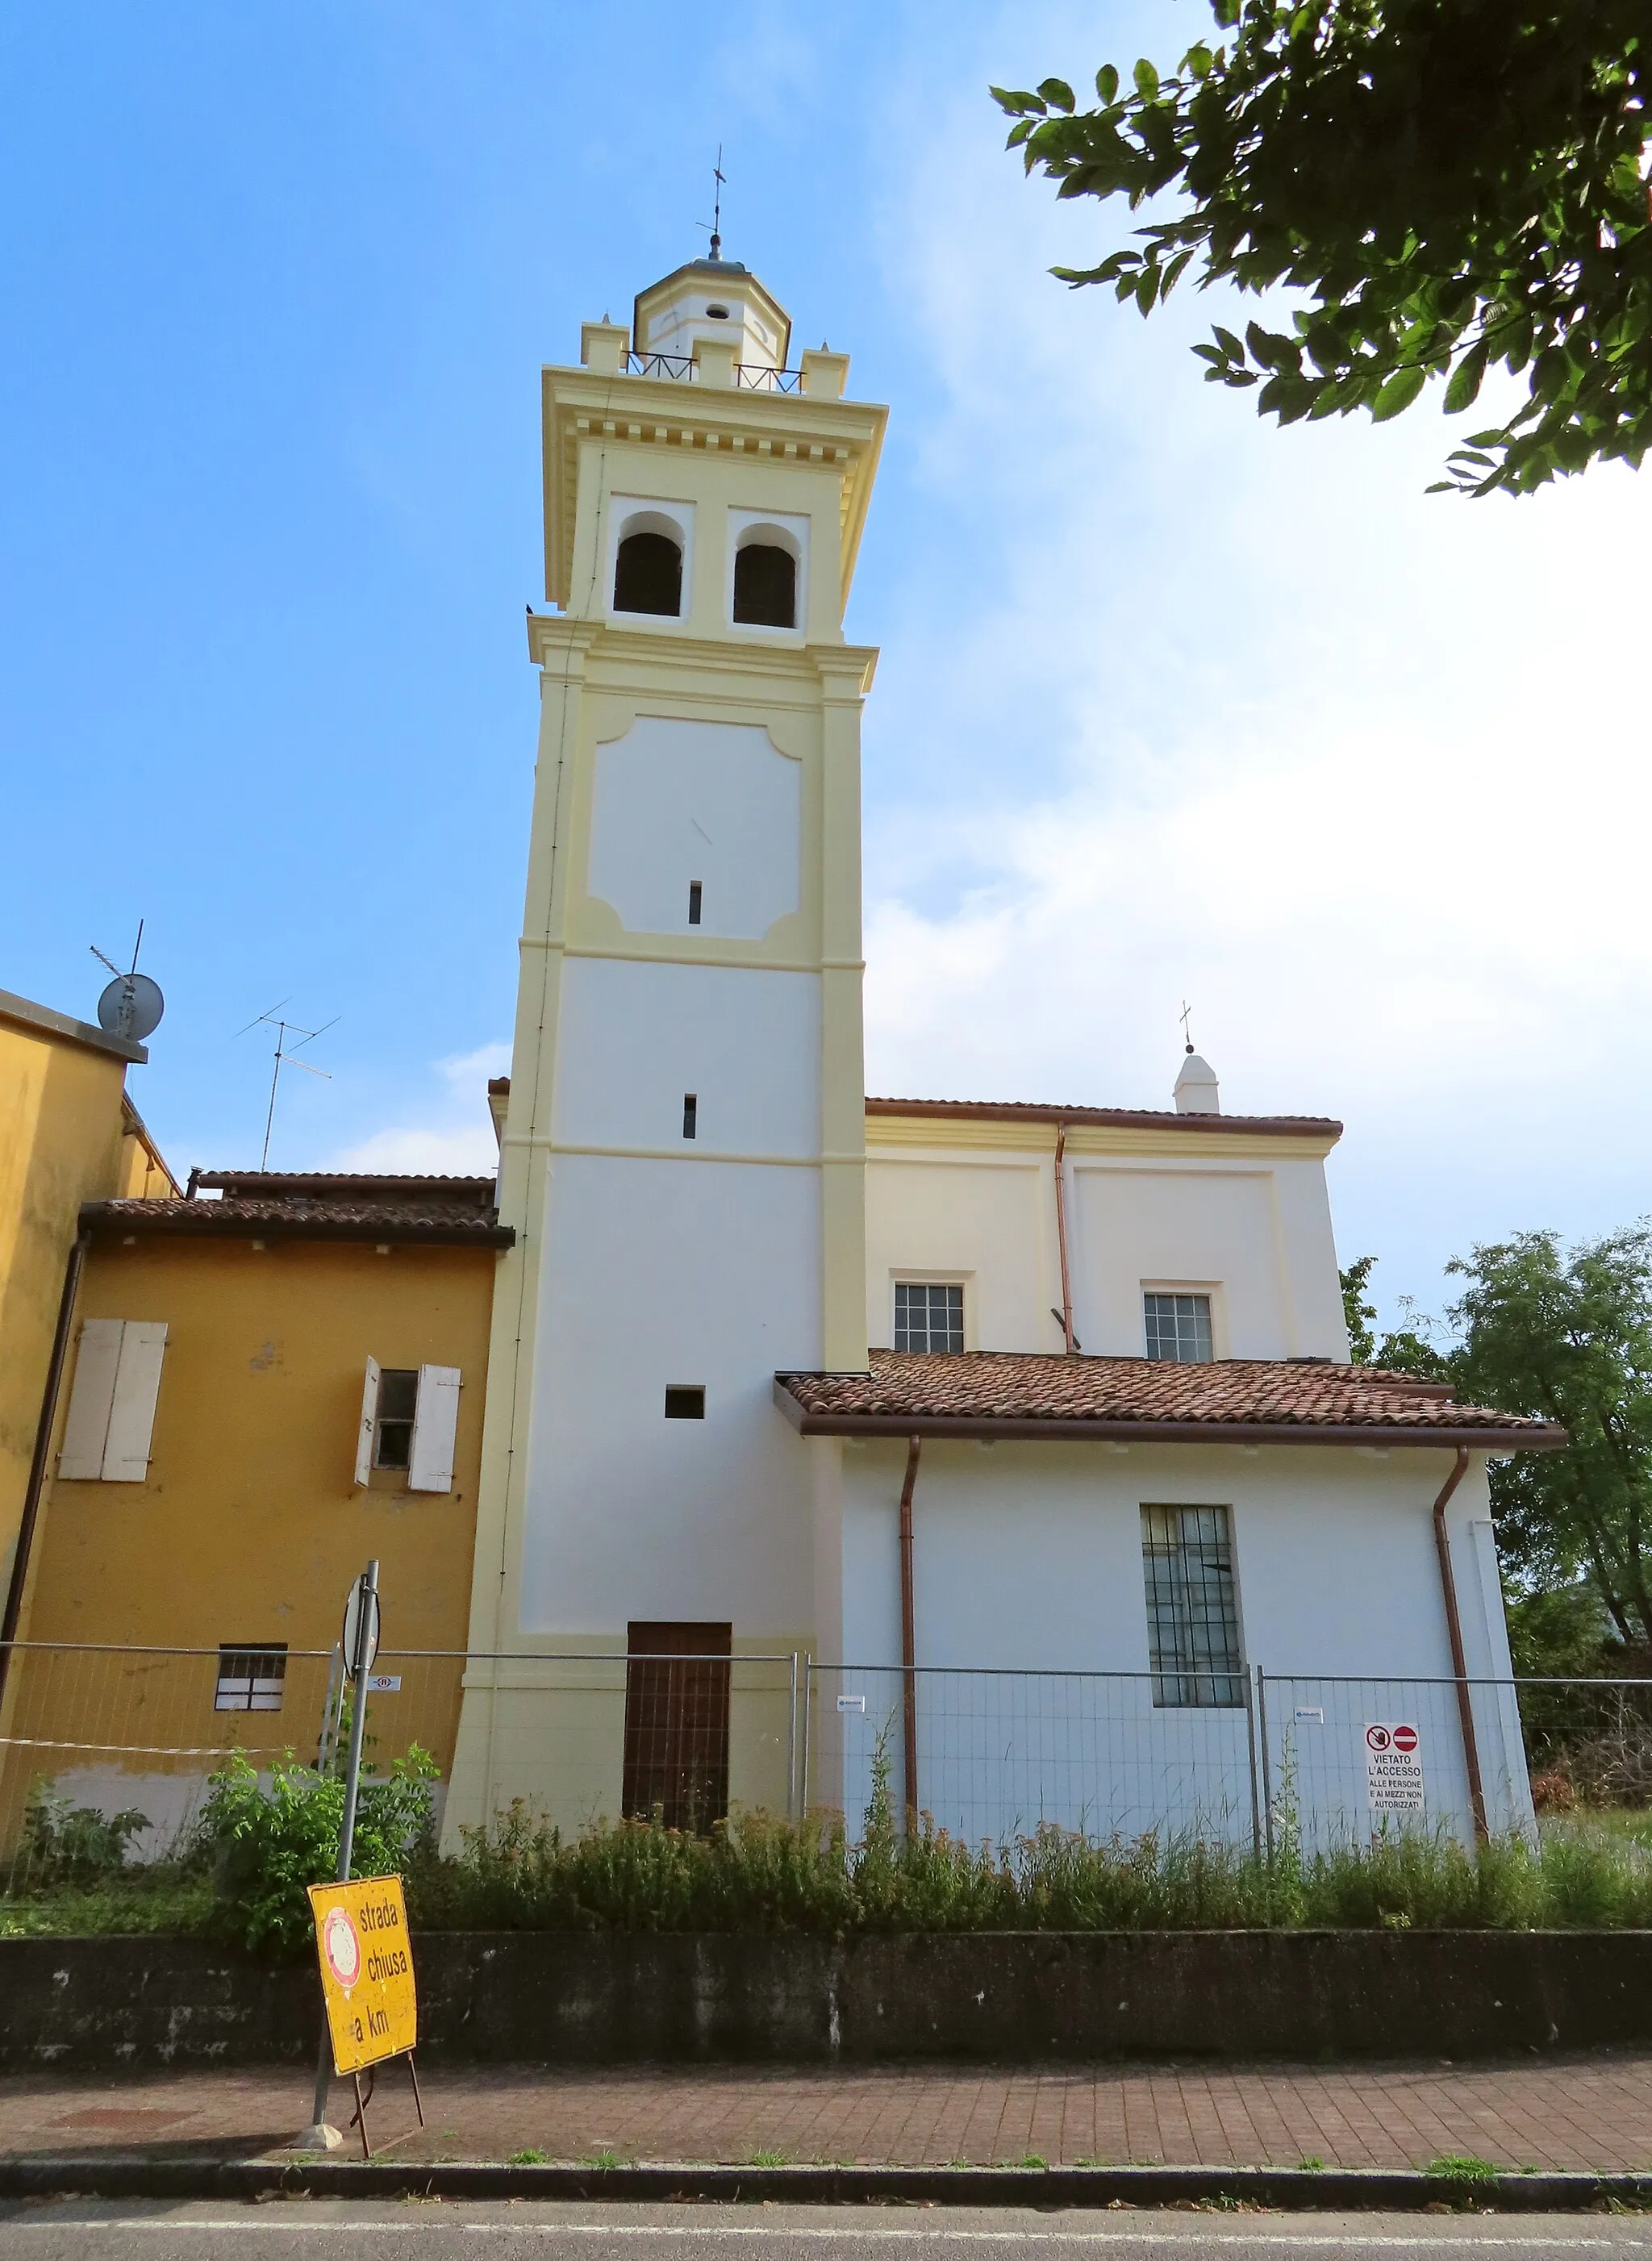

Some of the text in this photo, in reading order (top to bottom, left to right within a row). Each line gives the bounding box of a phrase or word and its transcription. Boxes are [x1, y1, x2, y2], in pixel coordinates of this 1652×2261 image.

[1374, 1754, 1411, 1764] VIETATO
[1368, 1767, 1420, 1776] L'ACCESSO
[1369, 1779, 1421, 1788] ALLE PERSONE
[1407, 1791, 1422, 1799] NON
[1375, 1800, 1419, 1808] AUTORIZZATI
[360, 1897, 398, 1933] strada
[367, 1947, 407, 1982] chiusa
[354, 2005, 390, 2042] a km
